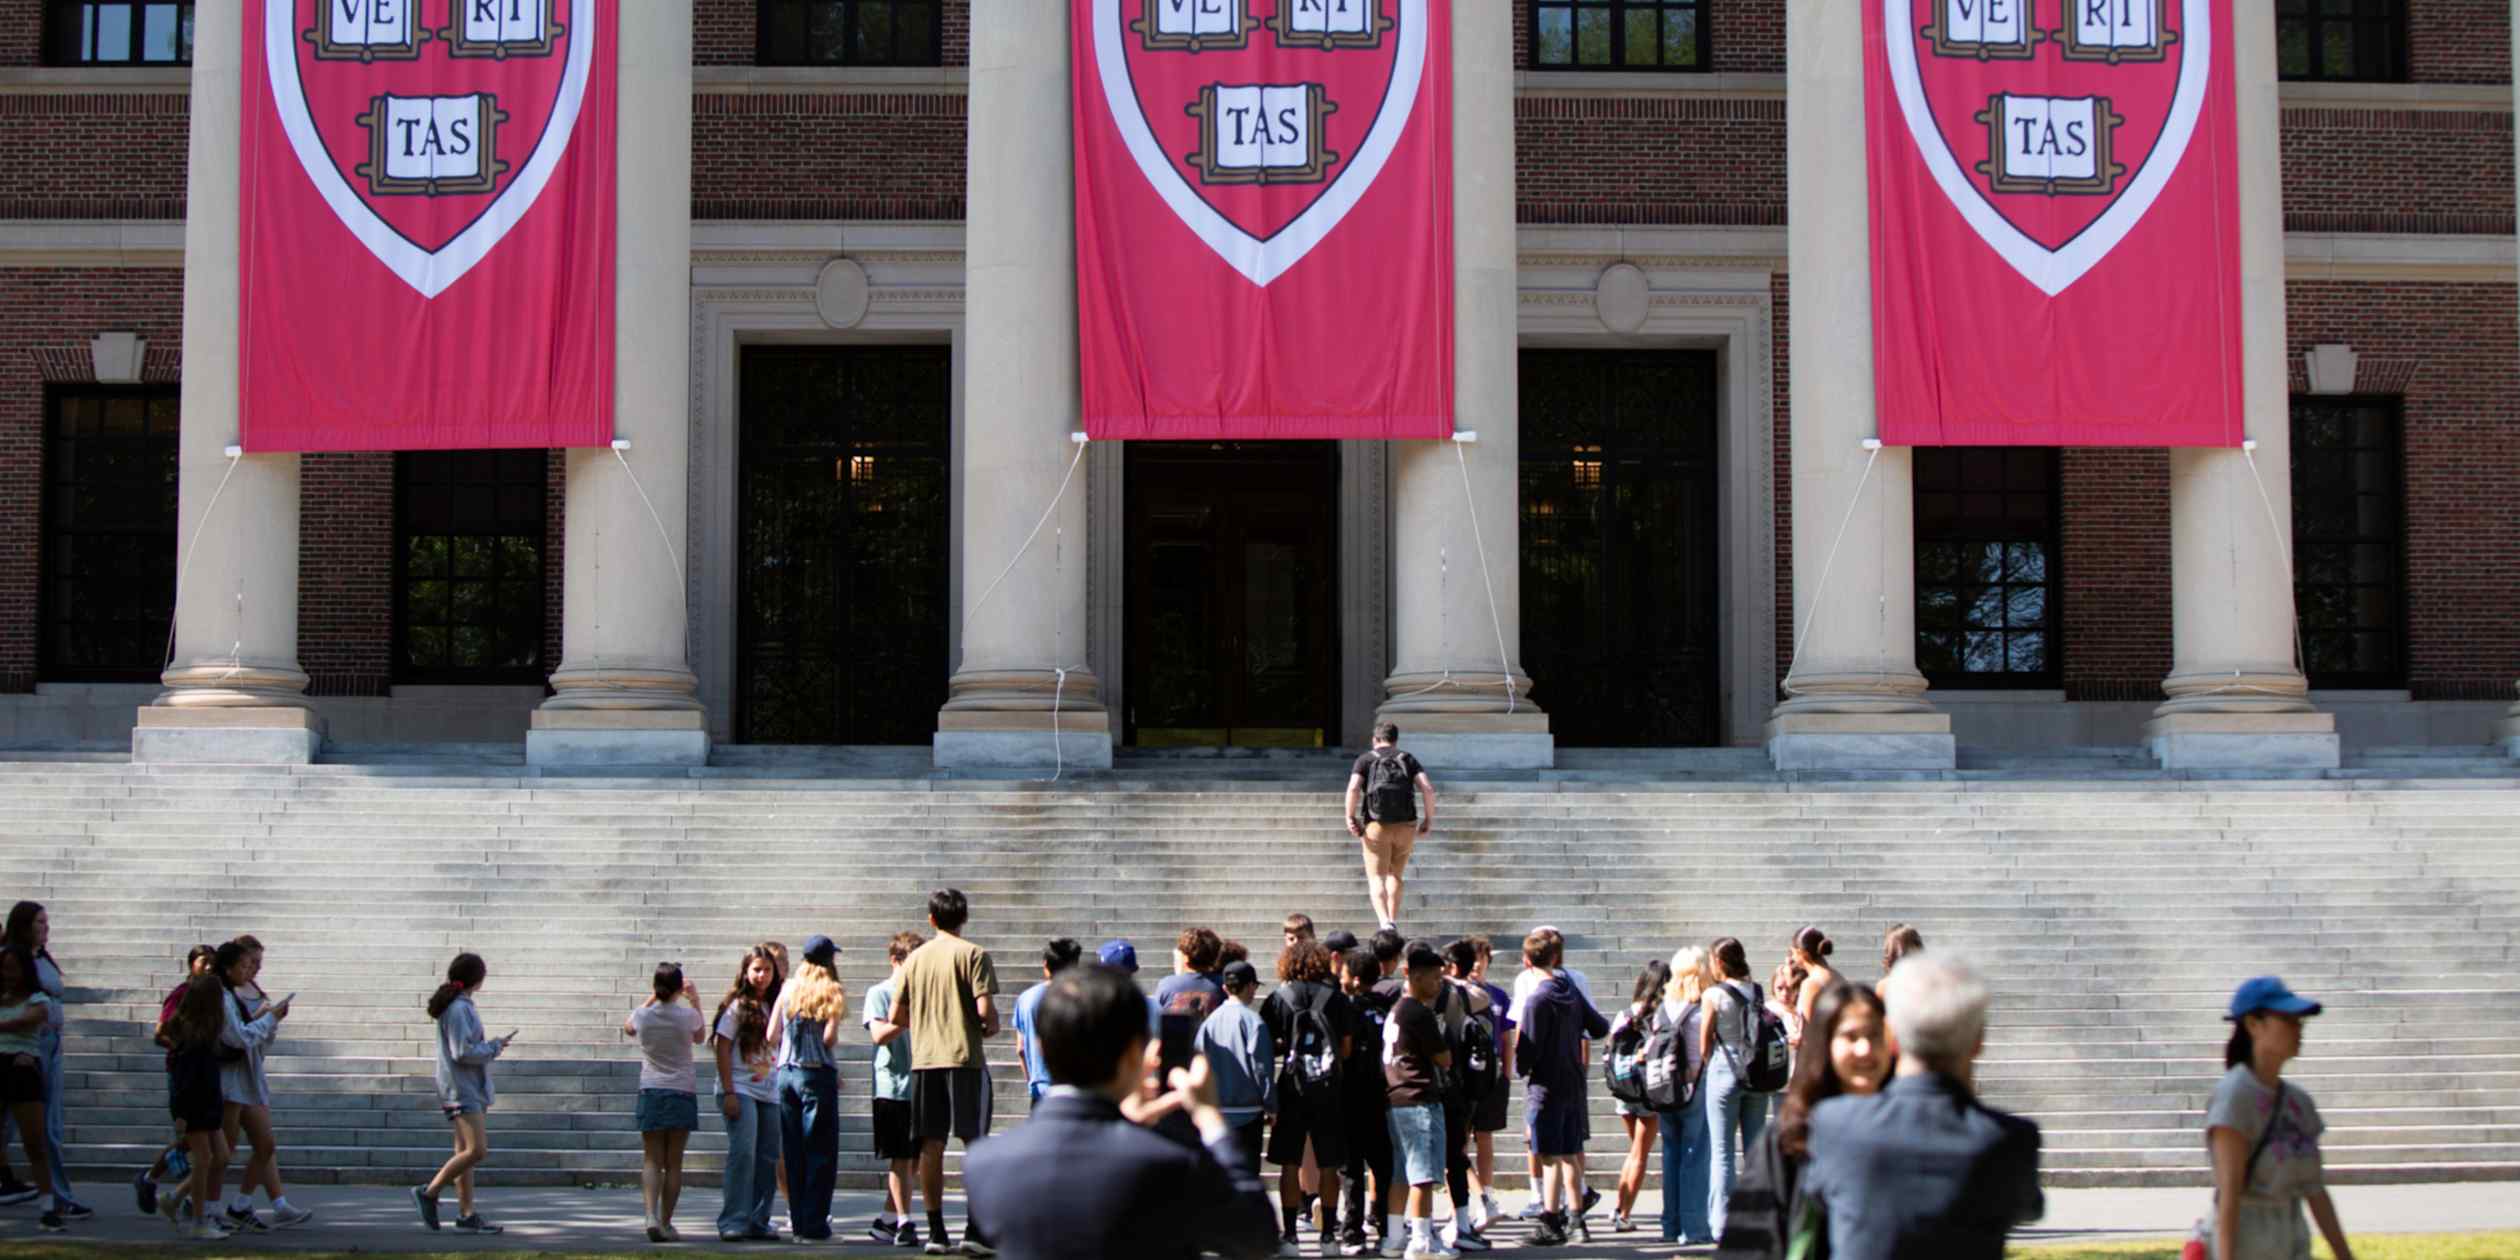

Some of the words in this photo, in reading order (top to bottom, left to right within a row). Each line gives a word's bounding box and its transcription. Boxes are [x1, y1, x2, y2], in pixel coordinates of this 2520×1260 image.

[397, 118, 471, 156] TAS
[1226, 107, 1299, 146] TAS
[2014, 117, 2087, 156] TAS
[1646, 1054, 1677, 1086] EF
